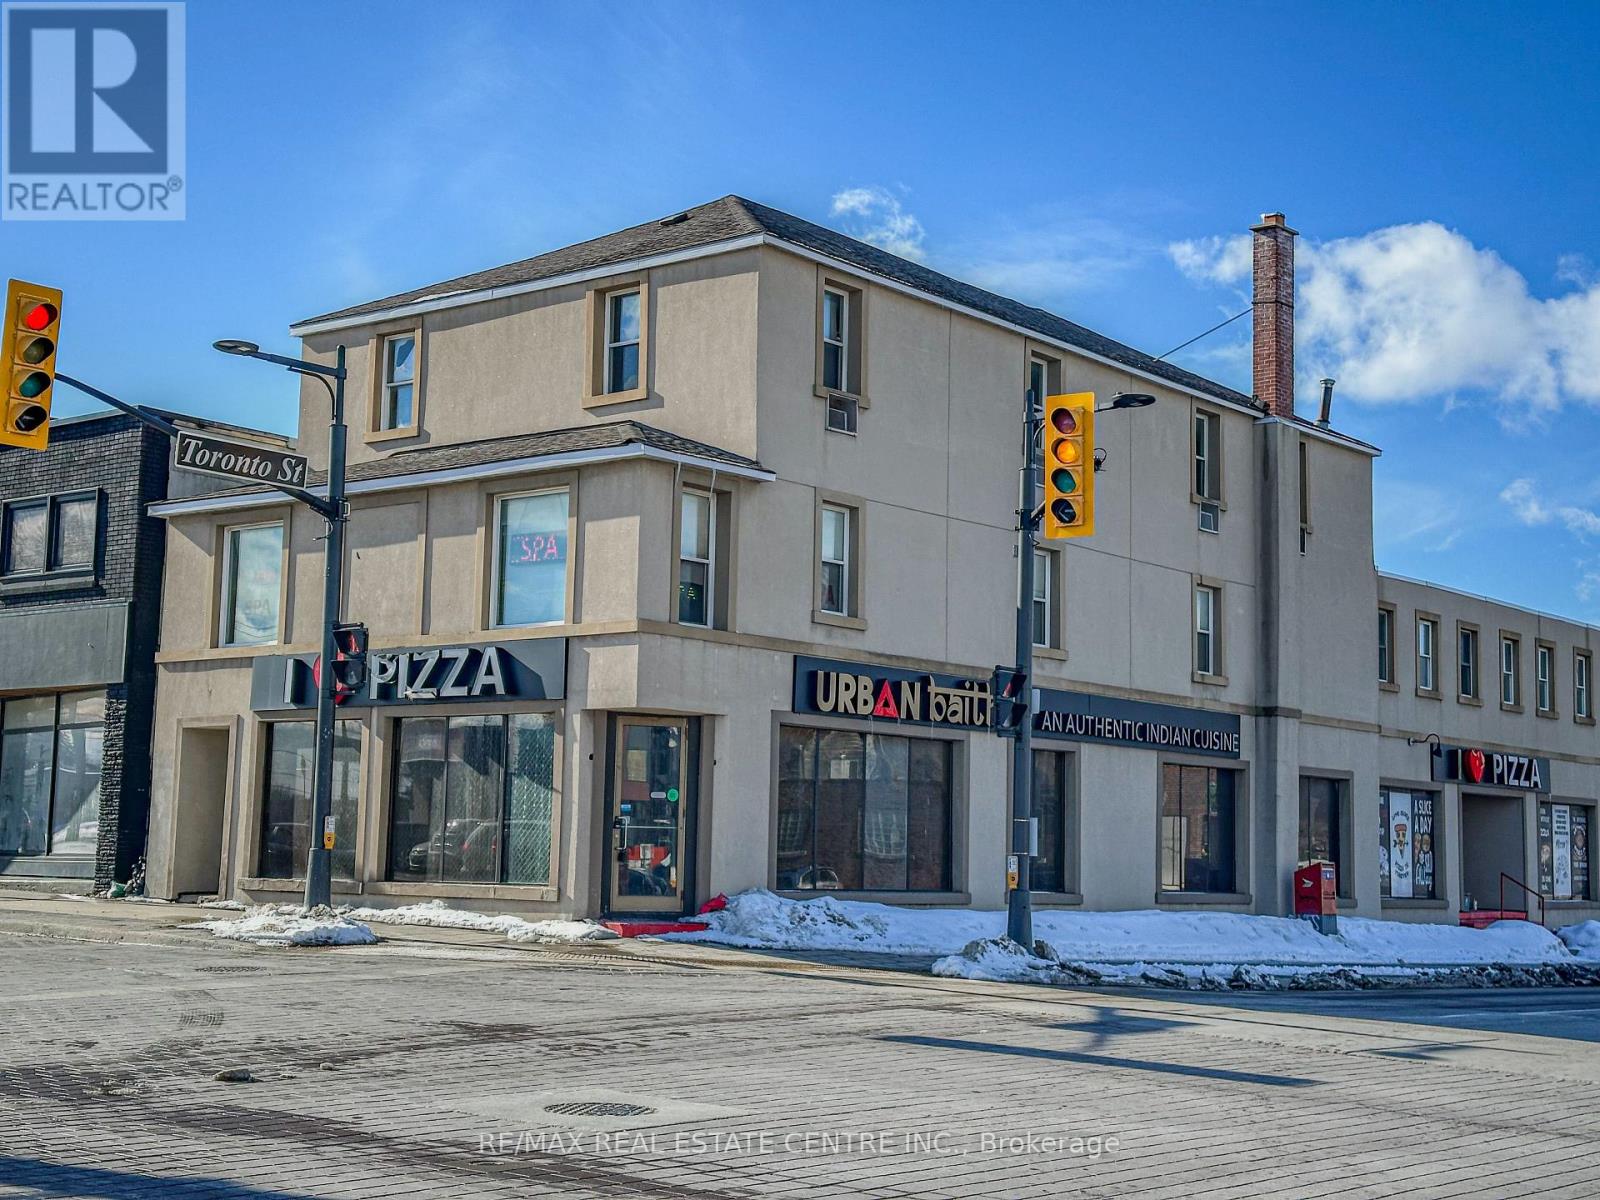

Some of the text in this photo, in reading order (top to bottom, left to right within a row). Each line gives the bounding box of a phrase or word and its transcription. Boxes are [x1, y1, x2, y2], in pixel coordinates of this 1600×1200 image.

[182, 438, 303, 483] Toronto St
[521, 534, 559, 561] SPA
[283, 646, 506, 704] I PIZZA
[816, 669, 921, 721] URBAN
[1041, 710, 1239, 753] AN AUTHENTIC INDIAN CUISINE
[1493, 753, 1542, 789] PIZZA
[1420, 815, 1432, 834] DAY
